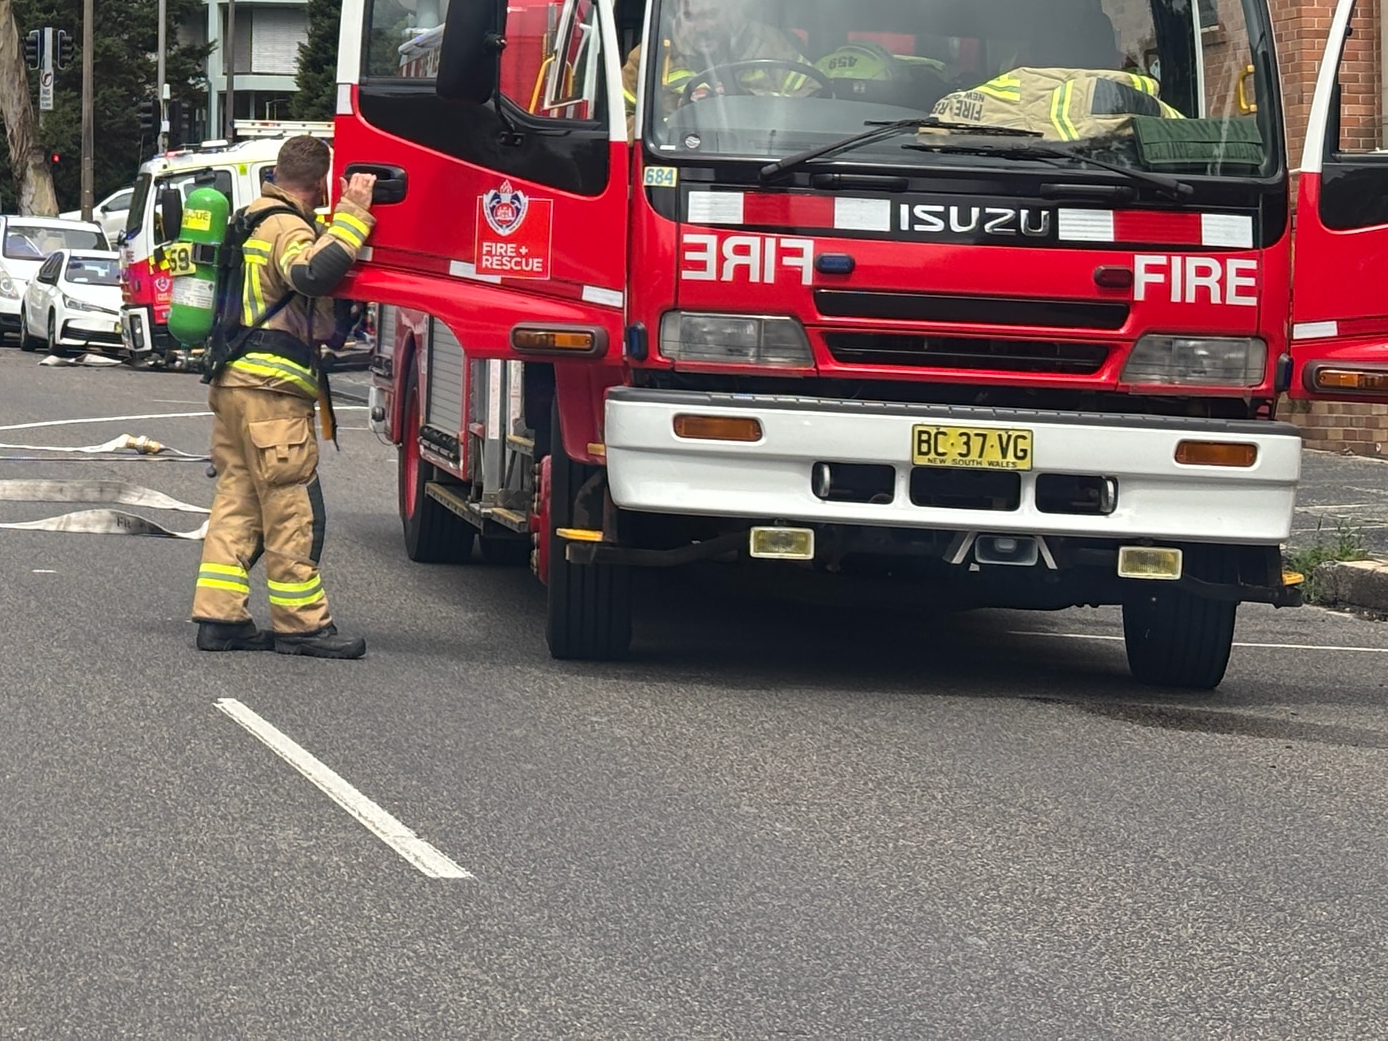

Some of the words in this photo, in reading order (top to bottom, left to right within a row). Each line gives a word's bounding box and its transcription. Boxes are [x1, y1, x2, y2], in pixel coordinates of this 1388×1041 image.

[954, 100, 983, 121] FIRE
[645, 168, 674, 185] 684
[900, 204, 1050, 237] ISUZU
[482, 242, 517, 257] FIRE
[482, 256, 543, 272] RESCUE
[1134, 255, 1258, 305] FIRE
[927, 457, 947, 465] NEW
[952, 458, 983, 467] SOUTH
[987, 460, 1018, 468] WALES
